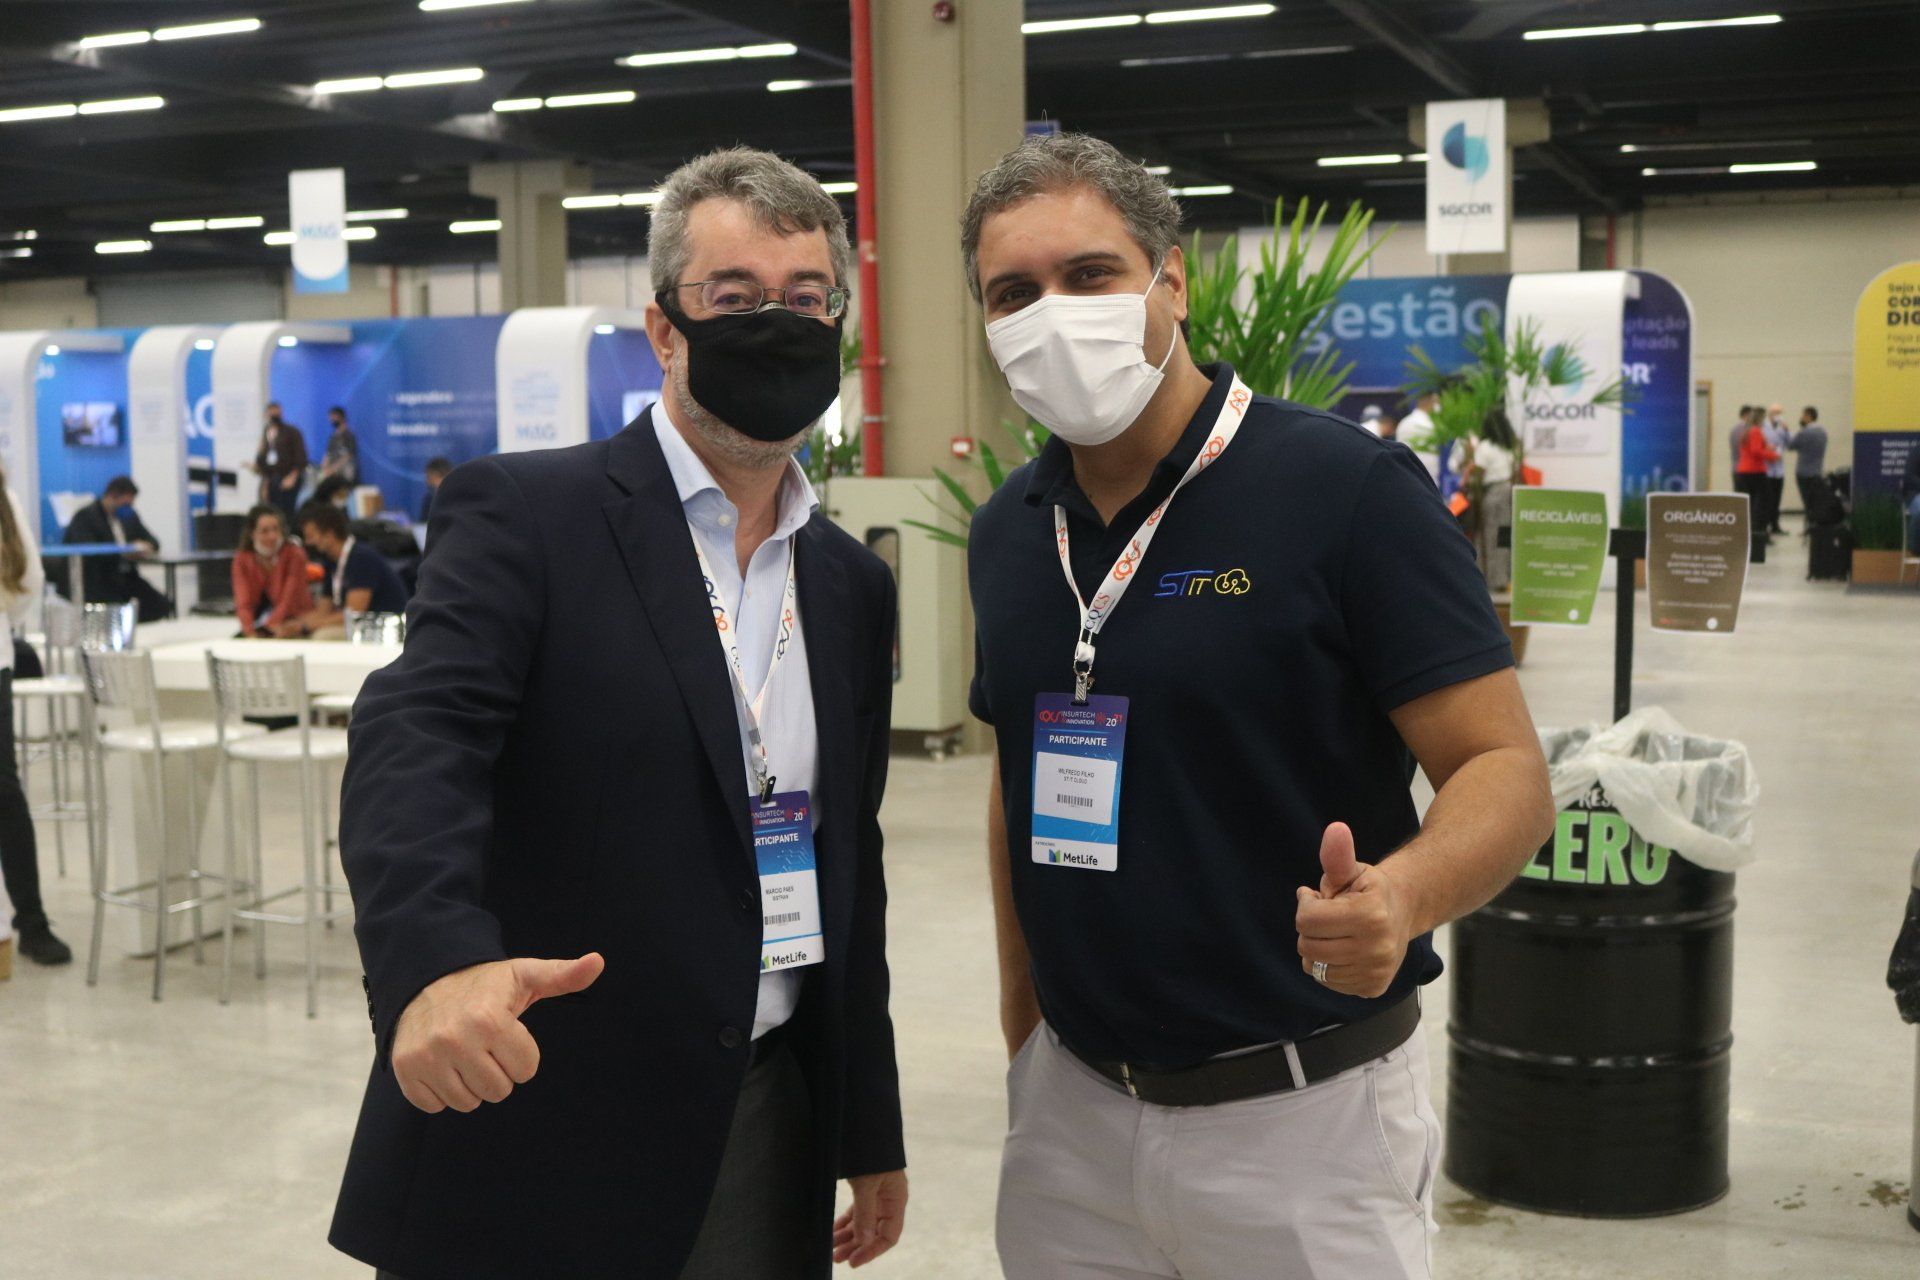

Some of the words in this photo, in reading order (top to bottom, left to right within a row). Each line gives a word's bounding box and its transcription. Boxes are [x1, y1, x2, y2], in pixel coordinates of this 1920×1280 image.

[1519, 509, 1604, 525] RECICLÁVEIS
[1663, 510, 1737, 525] ORGÂNICO
[1049, 735, 1108, 747] PARTICIPANTE
[1063, 852, 1098, 866] MetLife
[772, 951, 808, 966] MetLife
